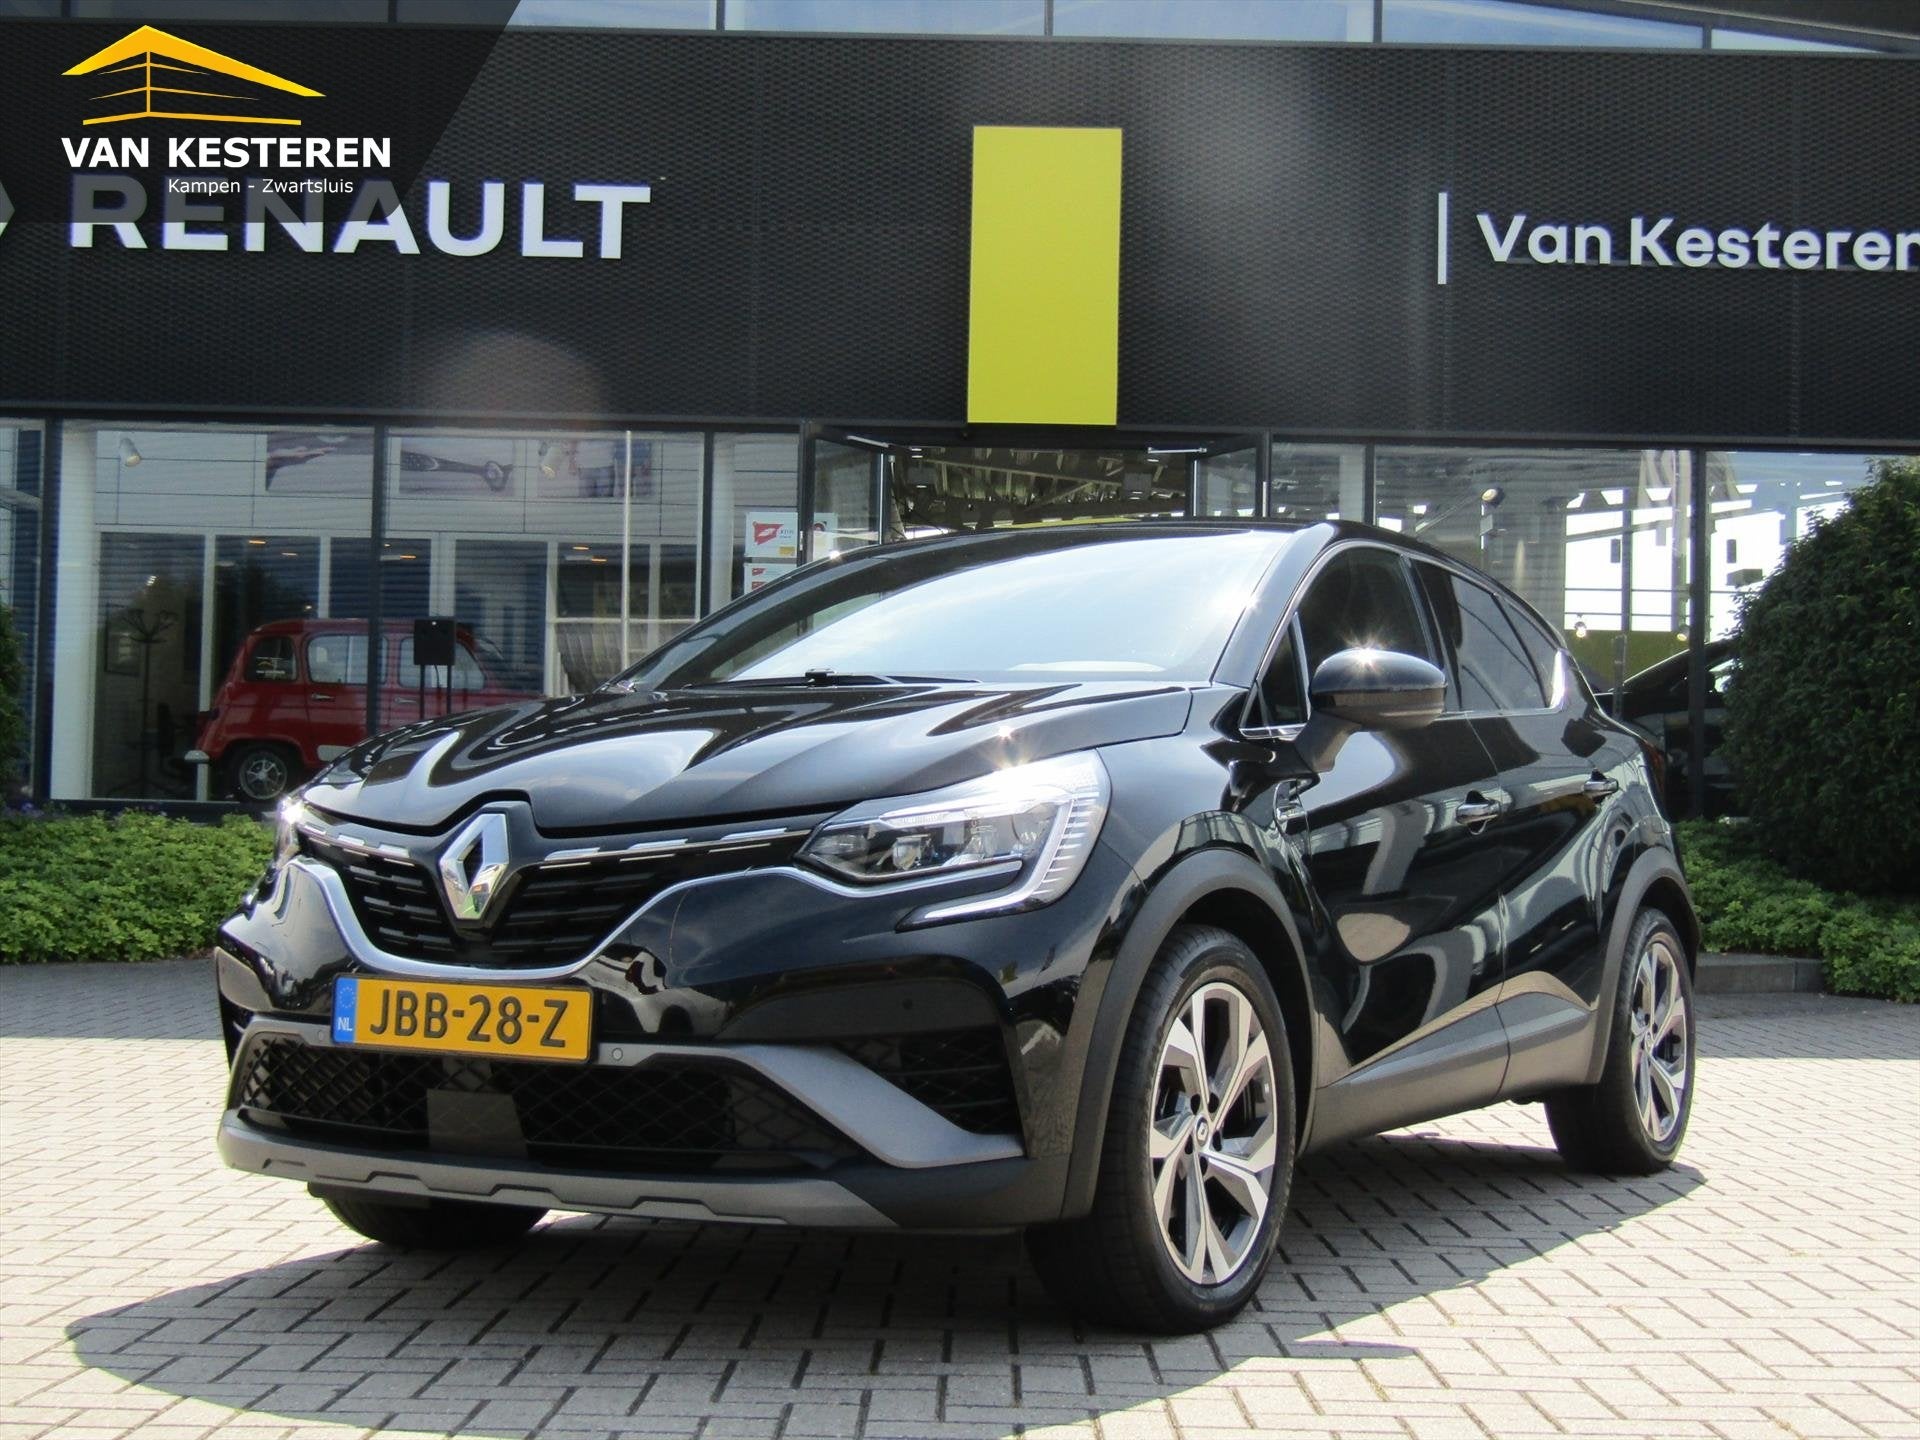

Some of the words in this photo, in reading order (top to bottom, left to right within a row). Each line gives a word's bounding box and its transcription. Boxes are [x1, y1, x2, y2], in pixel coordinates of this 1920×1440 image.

[70, 174, 652, 260] RENAULT
[1475, 213, 1613, 265] Van
[1629, 217, 1920, 271] Kesteren
[337, 1016, 353, 1032] NL
[369, 988, 569, 1049] JBB-28-Z
